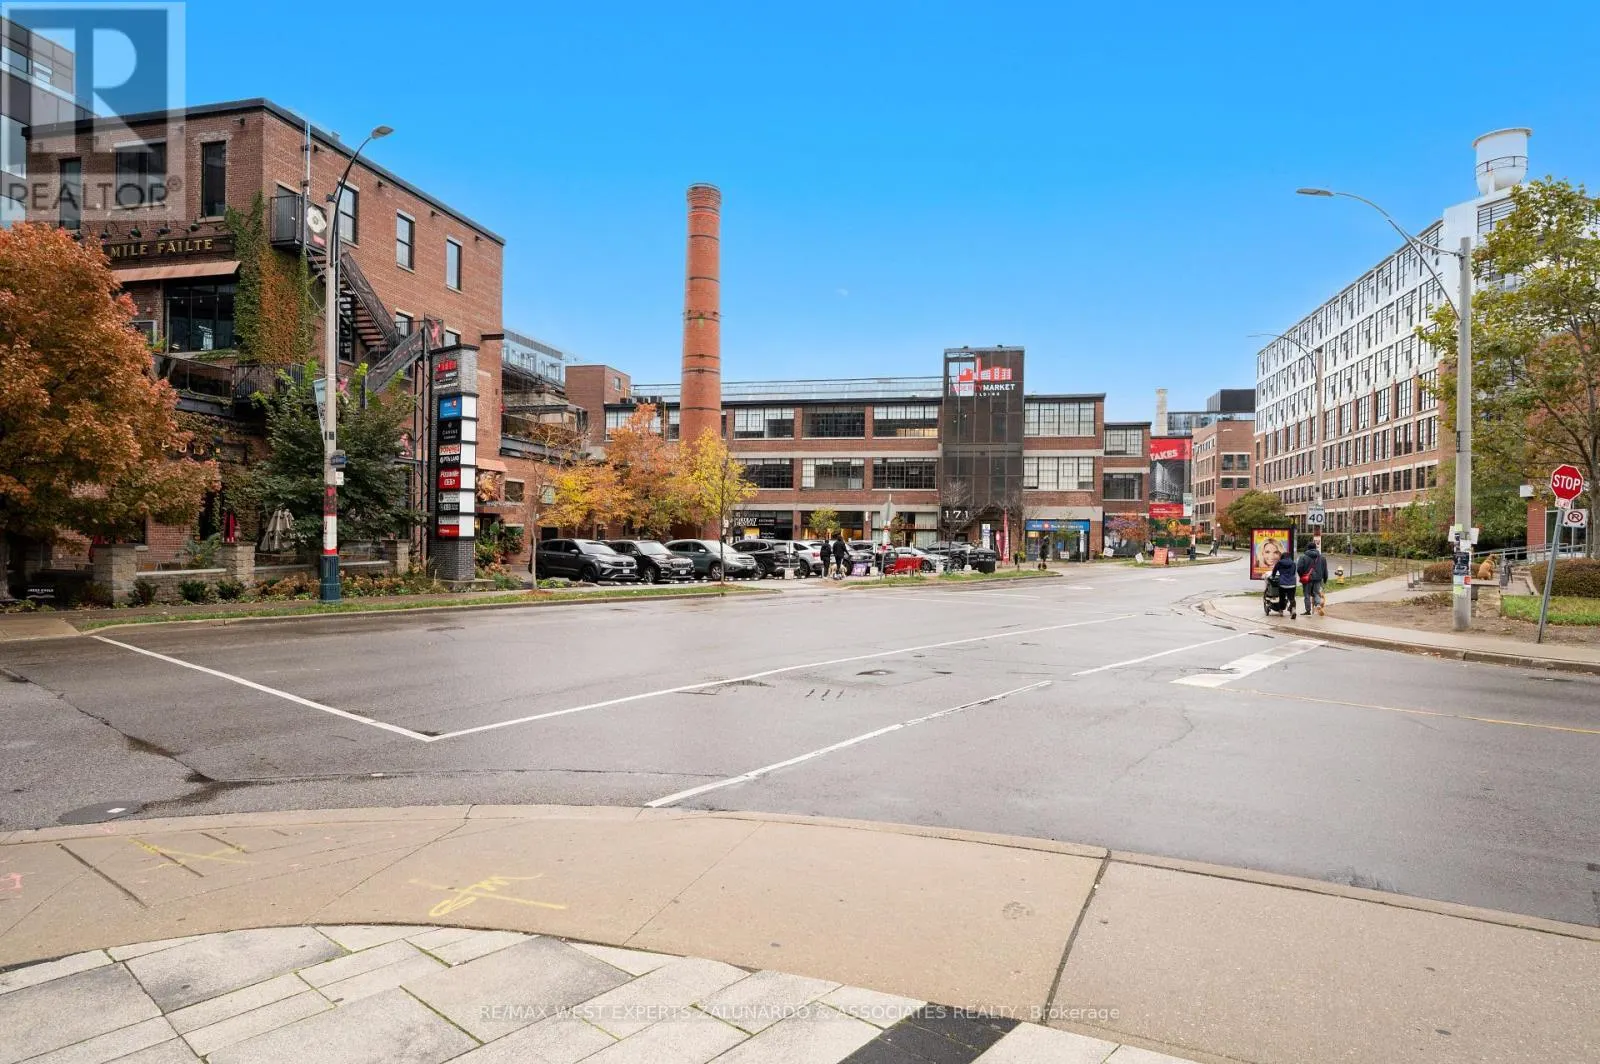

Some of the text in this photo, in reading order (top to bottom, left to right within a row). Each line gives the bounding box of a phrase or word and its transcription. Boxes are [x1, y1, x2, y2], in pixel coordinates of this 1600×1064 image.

[1150, 449, 1178, 461] TAKES
[1552, 474, 1581, 491] STOP
[945, 510, 969, 519] 171
[1308, 513, 1324, 523] 40
